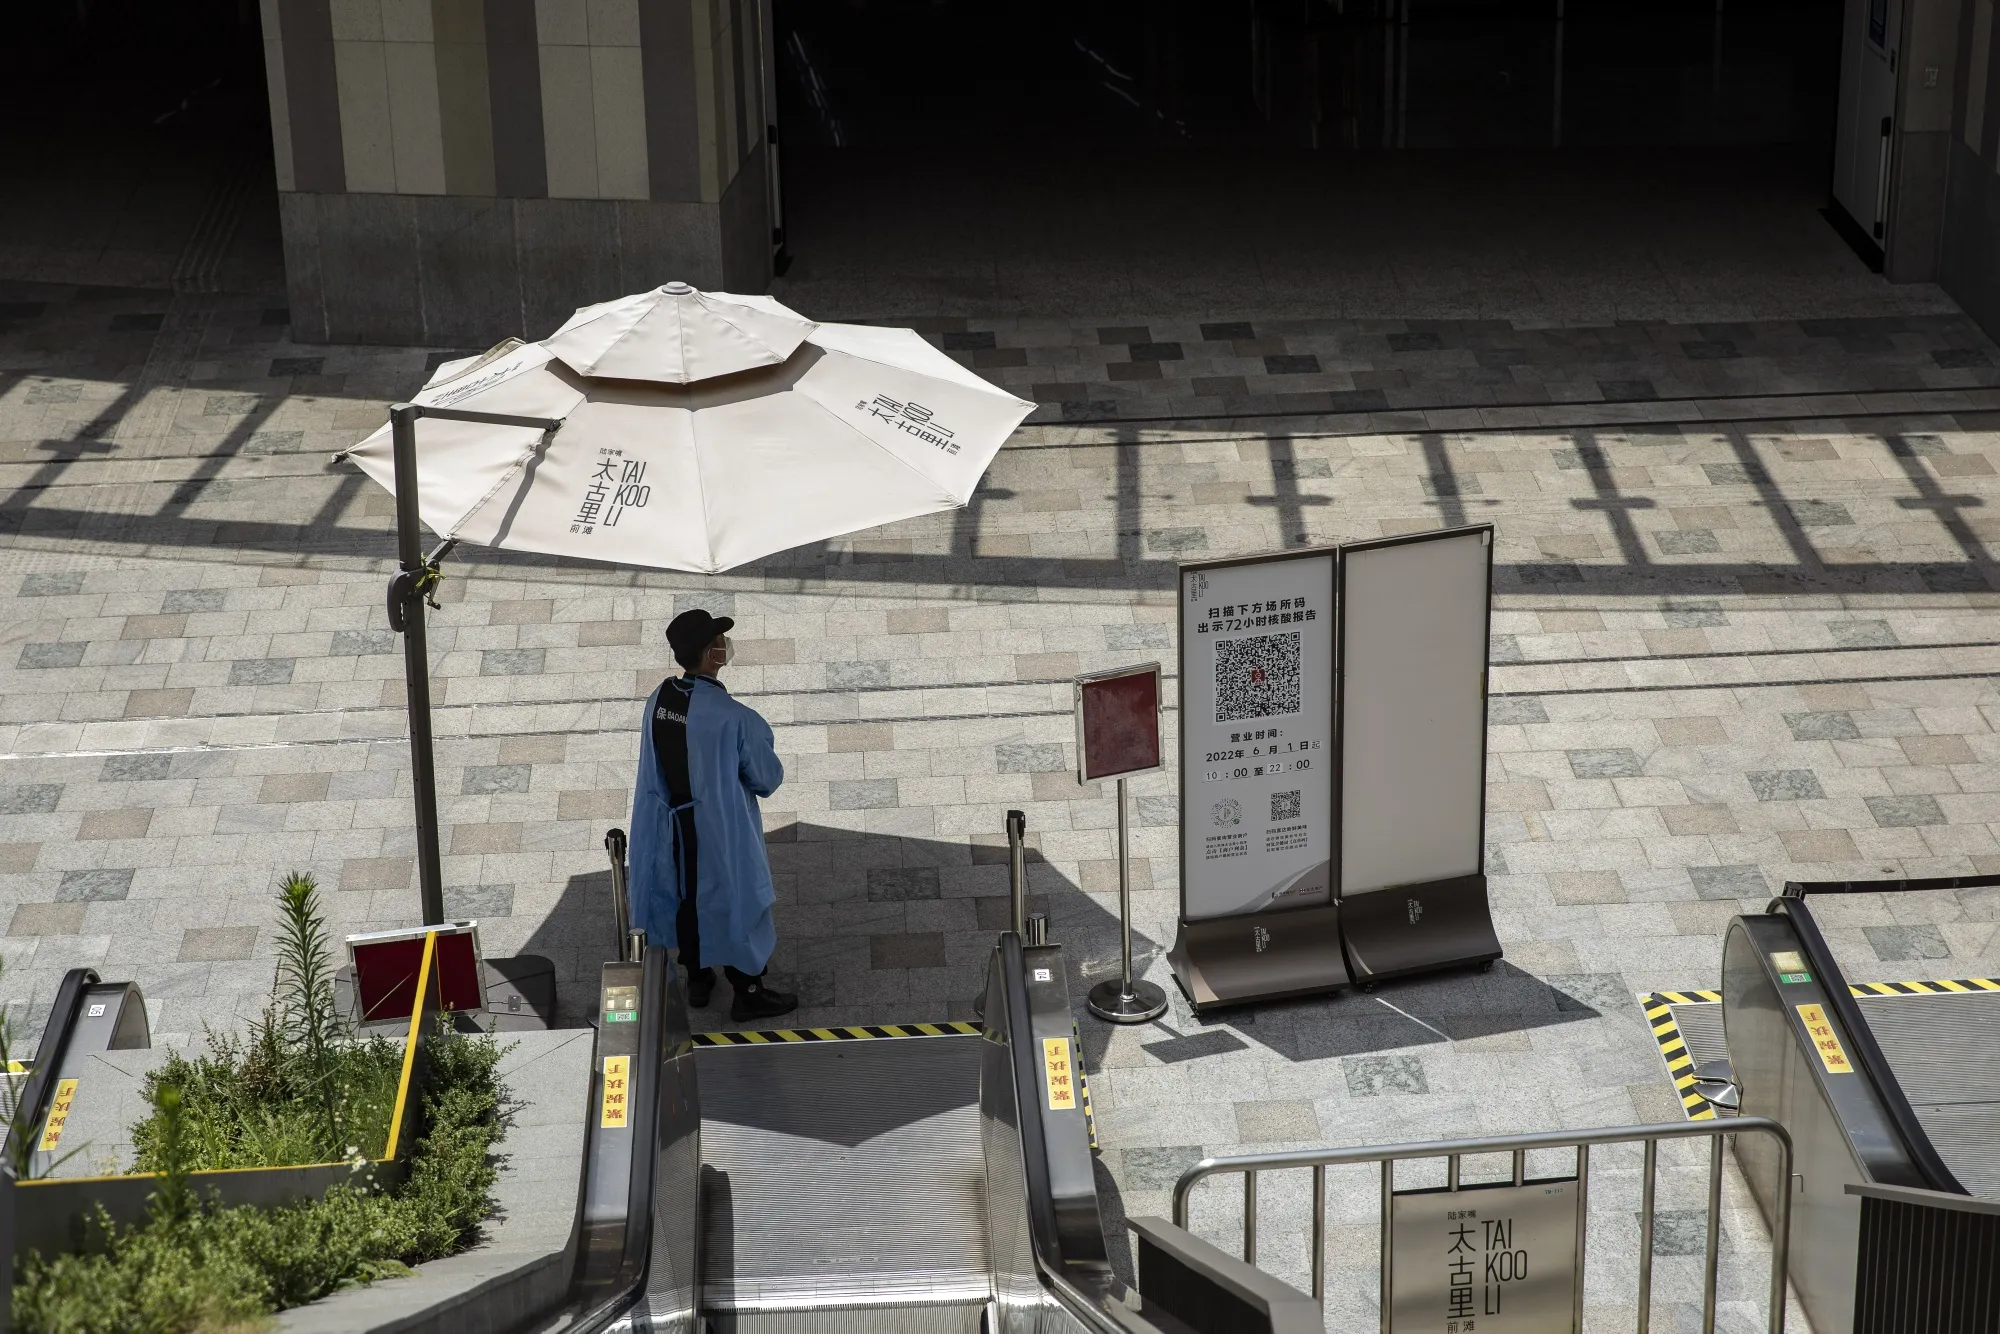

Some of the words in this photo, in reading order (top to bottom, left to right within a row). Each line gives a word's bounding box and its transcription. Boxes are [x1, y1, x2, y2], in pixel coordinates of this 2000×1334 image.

[872, 393, 904, 414] TAI
[900, 402, 934, 426] KOO
[621, 459, 647, 484] TAI
[573, 457, 618, 525] 太古里
[612, 484, 651, 508] KOO
[602, 505, 623, 527] LI
[1208, 597, 1306, 619] 扫描下方场所码
[1197, 609, 1317, 634] 出示72小时核酸报告
[656, 706, 667, 720] 保
[1447, 1209, 1477, 1221] 陆家嘴
[1481, 1218, 1512, 1250] TAI
[1447, 1222, 1476, 1319] 太古里
[1485, 1250, 1528, 1283] KOO
[1485, 1284, 1500, 1315] LI
[1447, 1319, 1475, 1334] 前滩
